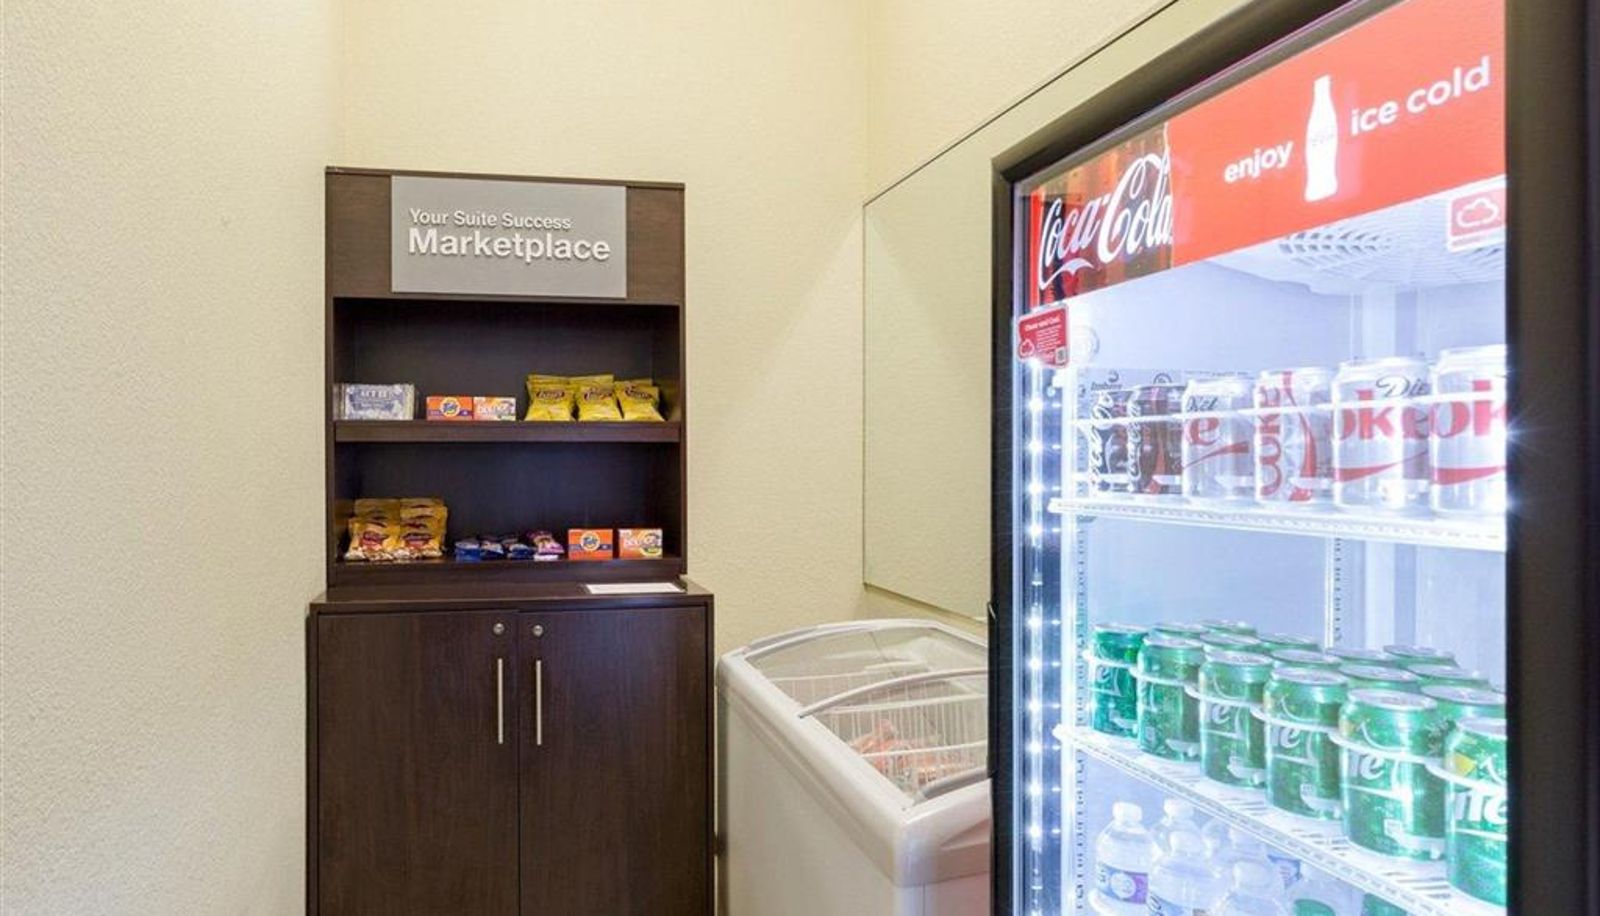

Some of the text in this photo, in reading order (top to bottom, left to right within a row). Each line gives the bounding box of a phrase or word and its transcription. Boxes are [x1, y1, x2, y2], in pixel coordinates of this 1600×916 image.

[1224, 55, 1491, 184] enjoy ice cold
[408, 207, 573, 231] Your Suite Success
[408, 227, 611, 262] Marketplace
[1376, 375, 1431, 397] Die
